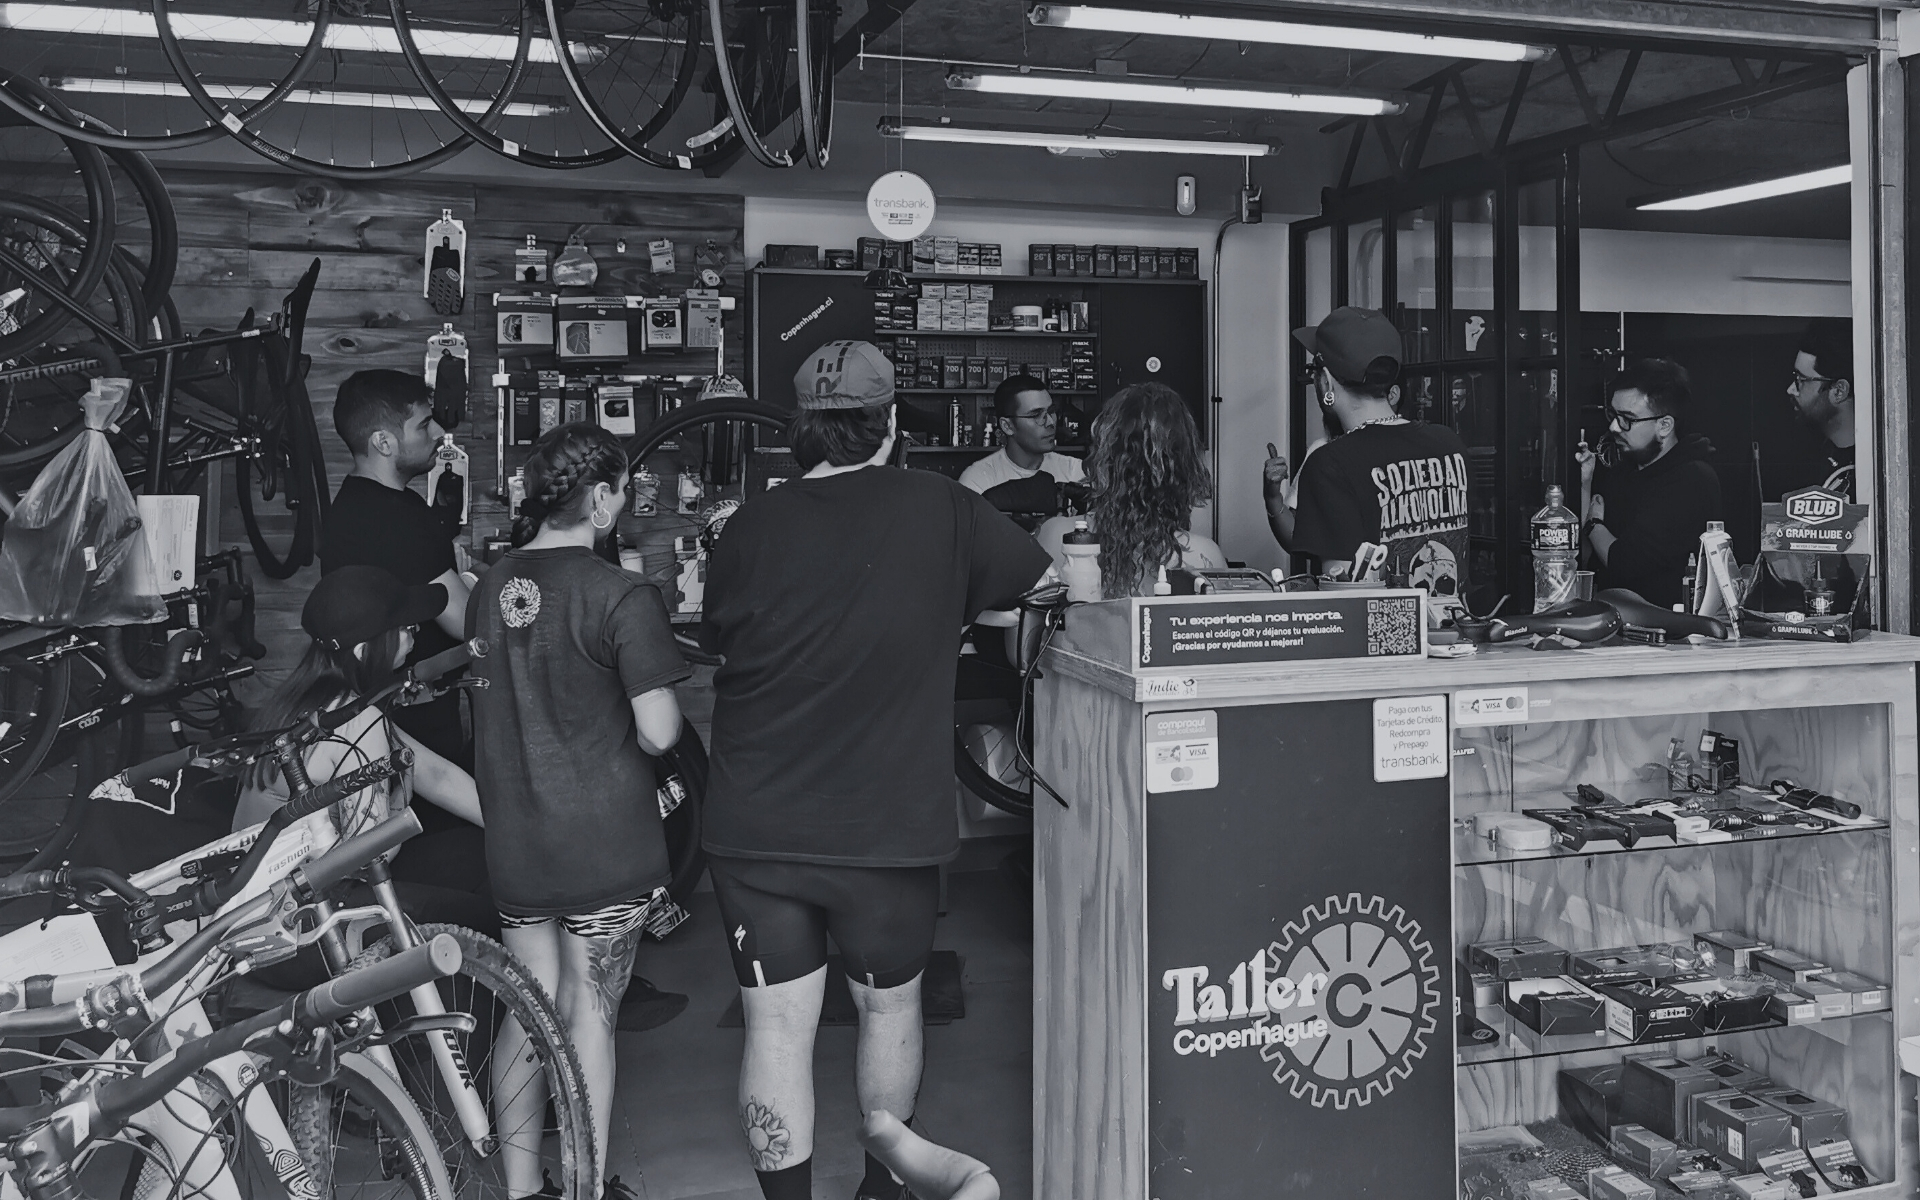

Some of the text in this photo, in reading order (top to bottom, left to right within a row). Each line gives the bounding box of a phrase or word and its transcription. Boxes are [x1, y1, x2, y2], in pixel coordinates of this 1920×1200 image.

[780, 296, 834, 341] Copenhague.cl
[1371, 453, 1468, 508] SOZIEDAD
[1793, 499, 1837, 516] BLUB
[1539, 528, 1569, 537] POWER
[1785, 528, 1843, 539] GRAPH LUBE
[1169, 617, 1187, 627] Tu
[1190, 612, 1262, 627] experiencia
[1265, 613, 1288, 623] nos
[1142, 607, 1152, 663] Copenhague
[1172, 624, 1344, 641] Escanea el código QR y déjanos tu evaluación.
[1777, 626, 1812, 635] GRAPH LUBE
[1172, 641, 1205, 653] ¡Gracias
[1206, 642, 1221, 652] por
[1222, 638, 1263, 651] ayudarnos
[1270, 637, 1304, 649] mejorar!
[1146, 680, 1179, 693] Indie
[1388, 706, 1406, 716] Paga
[1377, 715, 1444, 728] Tarjetas de Crédito,
[1389, 729, 1431, 739] Redcompra
[1189, 748, 1207, 756] VISA
[1398, 740, 1429, 750] Prepago
[267, 844, 310, 875] fashion
[1163, 949, 1328, 1025] Taller
[503, 966, 561, 1046] CST OPTIMUS
[1173, 1018, 1328, 1057] Copenhague
